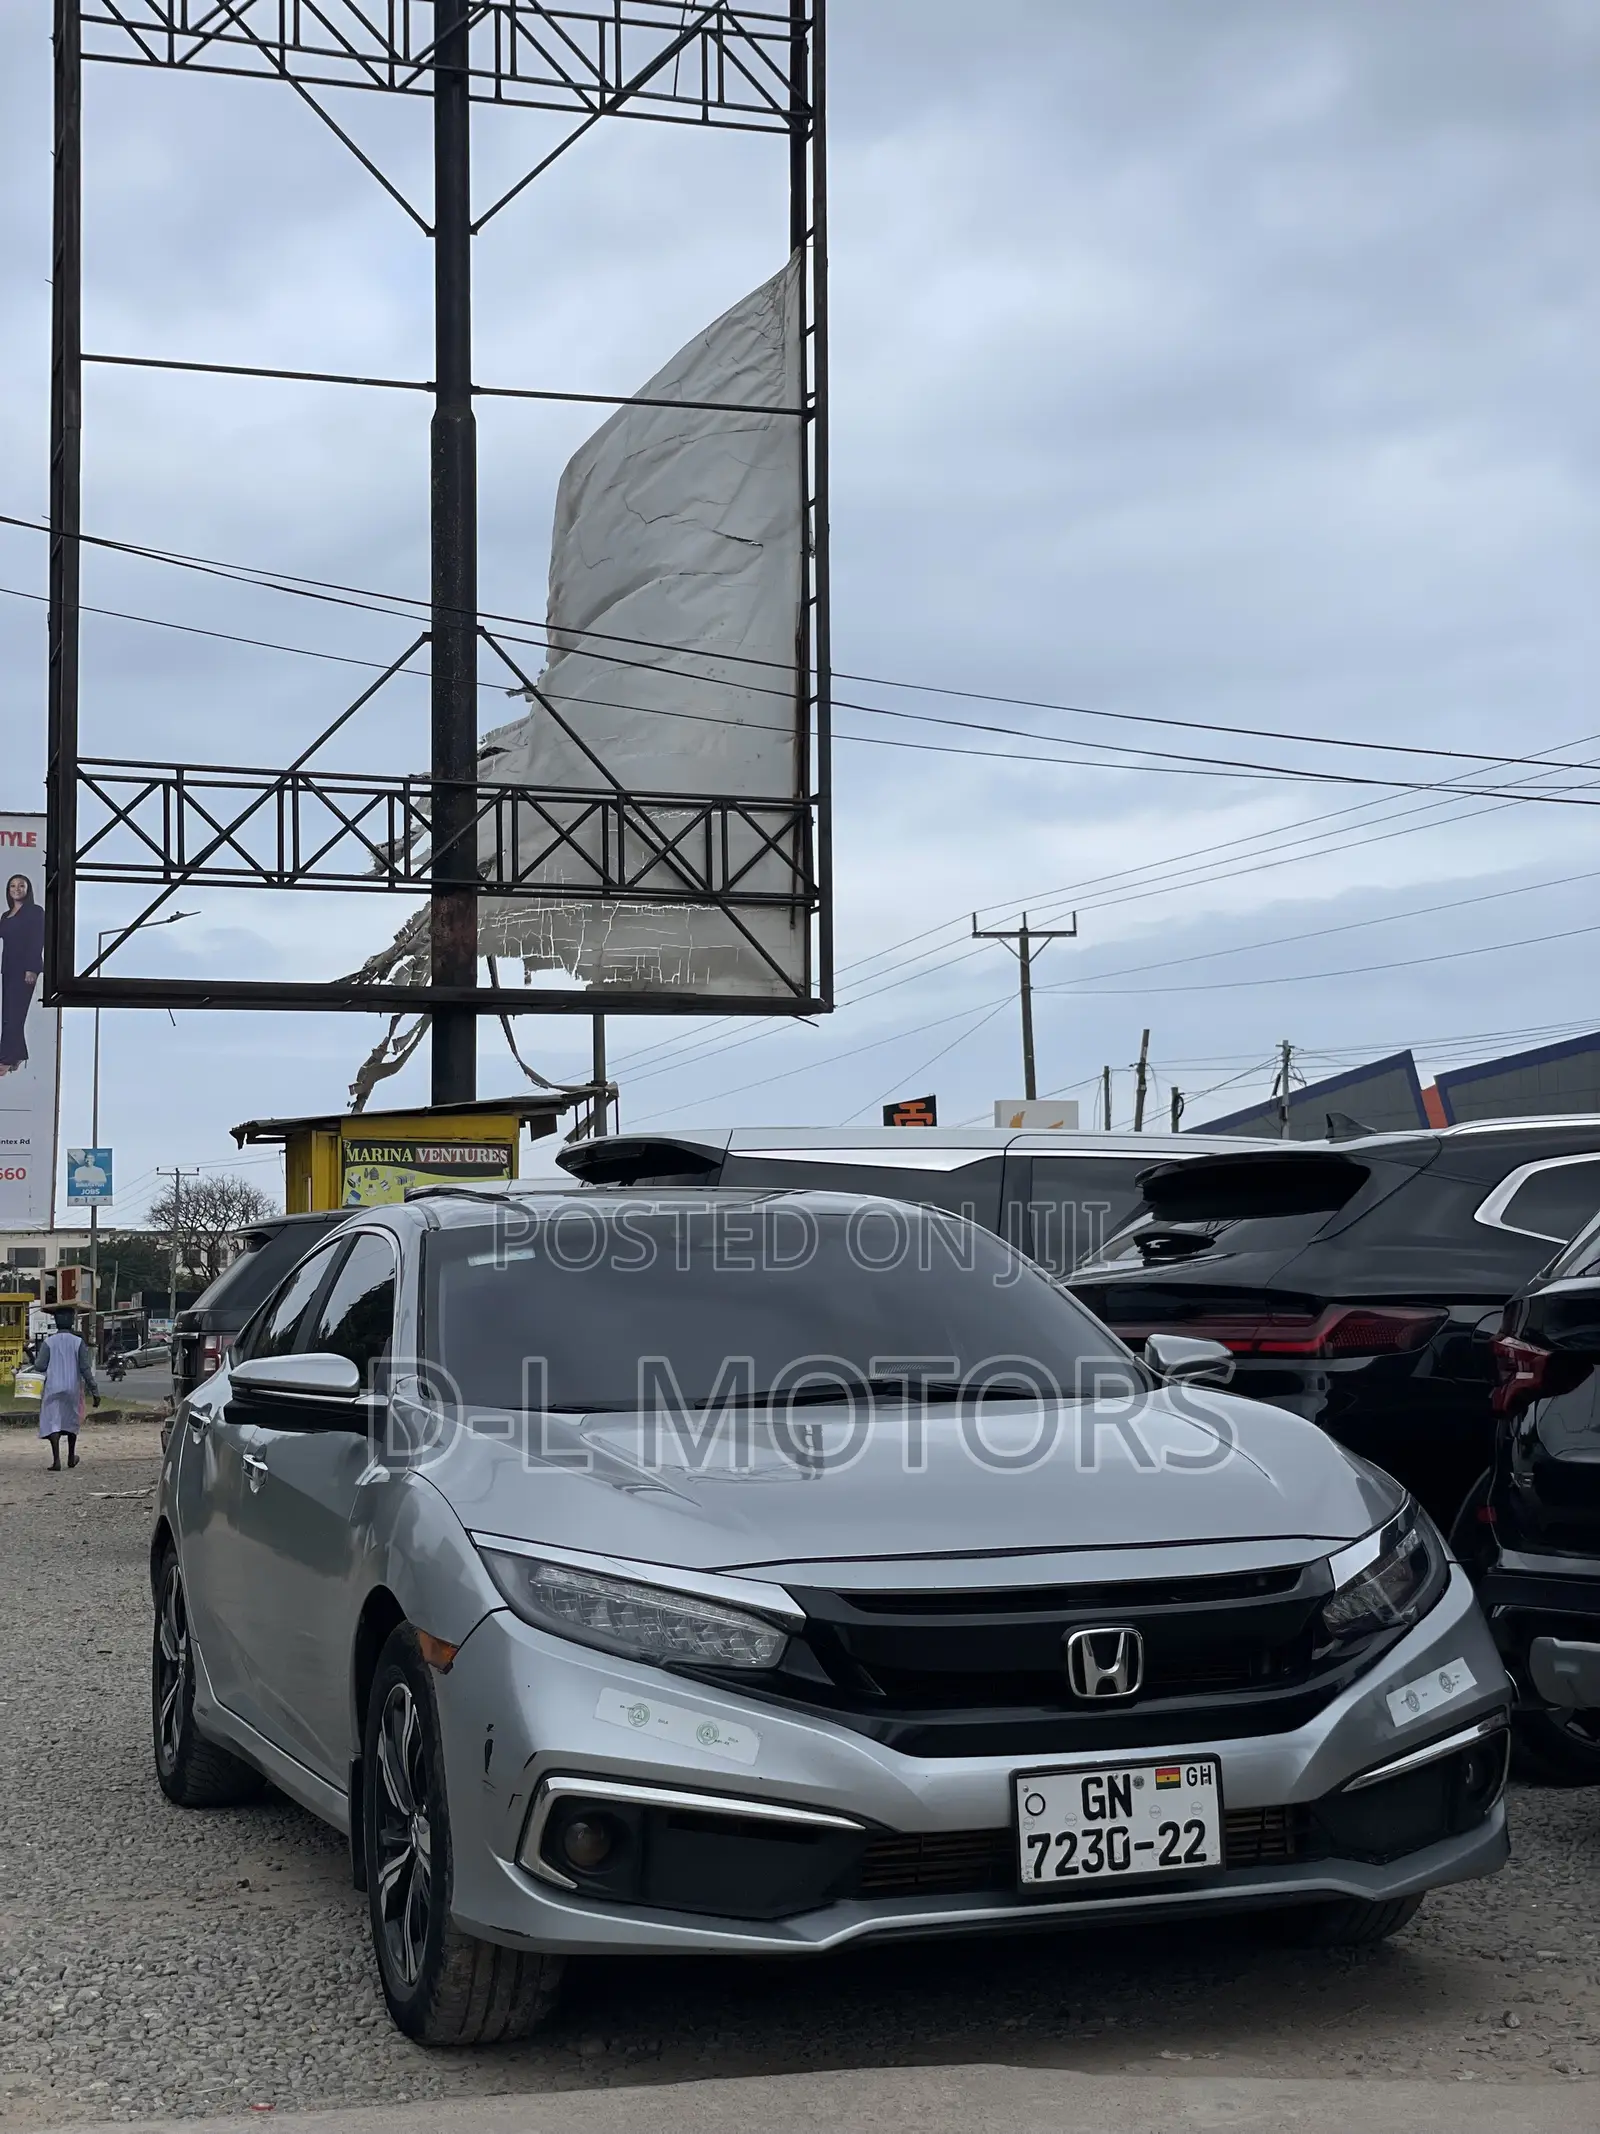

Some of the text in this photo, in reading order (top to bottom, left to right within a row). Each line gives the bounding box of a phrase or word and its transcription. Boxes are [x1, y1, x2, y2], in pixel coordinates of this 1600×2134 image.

[346, 1148, 508, 1164] MARINA VENTURES
[1186, 1764, 1212, 1787] GH
[1081, 1773, 1133, 1821] GN
[1027, 1819, 1207, 1879] 7230-22
